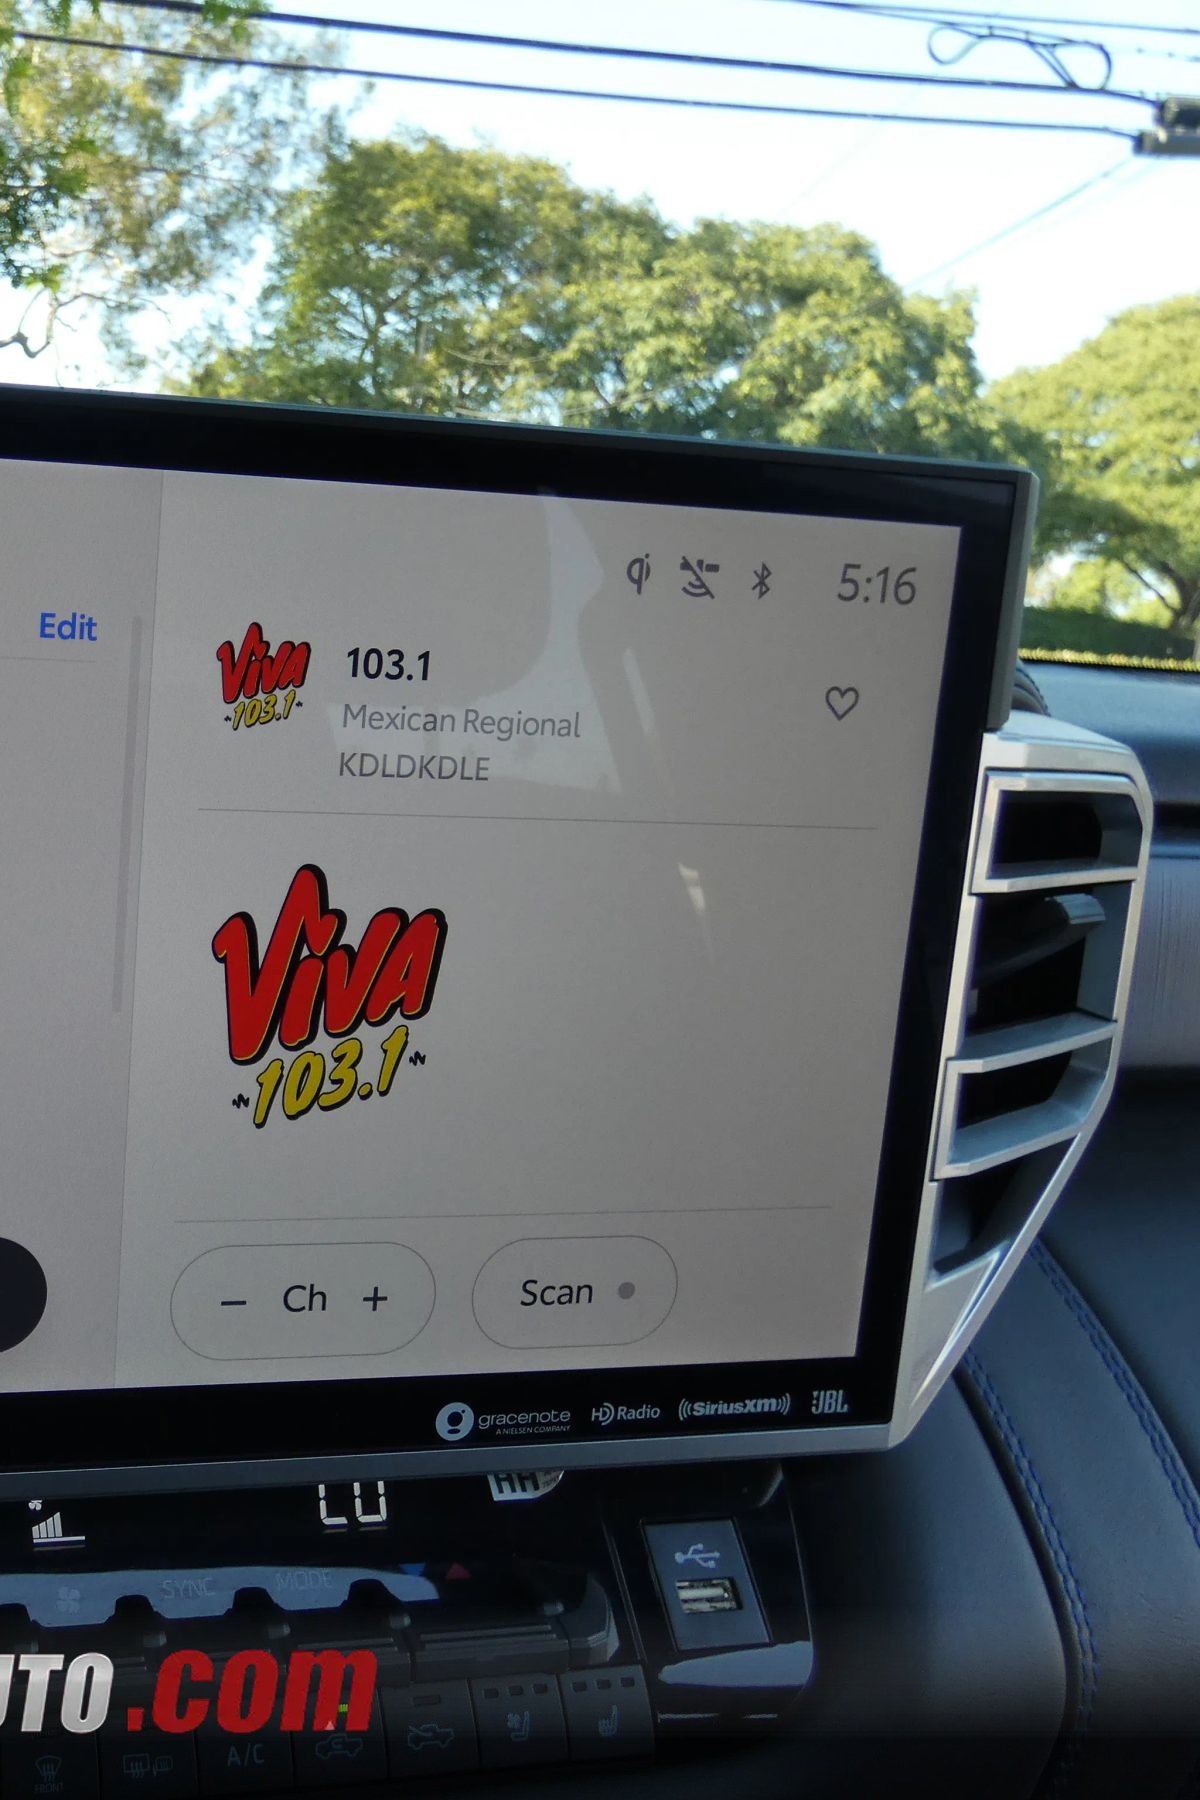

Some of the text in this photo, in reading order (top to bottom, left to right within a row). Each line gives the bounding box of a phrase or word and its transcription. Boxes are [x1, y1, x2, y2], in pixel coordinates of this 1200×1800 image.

[837, 563, 918, 605] 5:16
[39, 612, 98, 641] Edit
[346, 647, 432, 682] 103.1
[232, 689, 297, 731] 103.1
[343, 703, 582, 740] Mexican Regional
[338, 753, 491, 782] KDLDKDLE
[253, 1024, 409, 1129] 103.1
[283, 1284, 328, 1312] Ch
[520, 1278, 595, 1308] Scan
[617, 1405, 661, 1421] Radio
[811, 1389, 848, 1415] JBL
[478, 1410, 572, 1430] gracenote
[162, 1577, 217, 1600] SYNC
[275, 1568, 335, 1591] MODE
[226, 1742, 266, 1768] A/C
